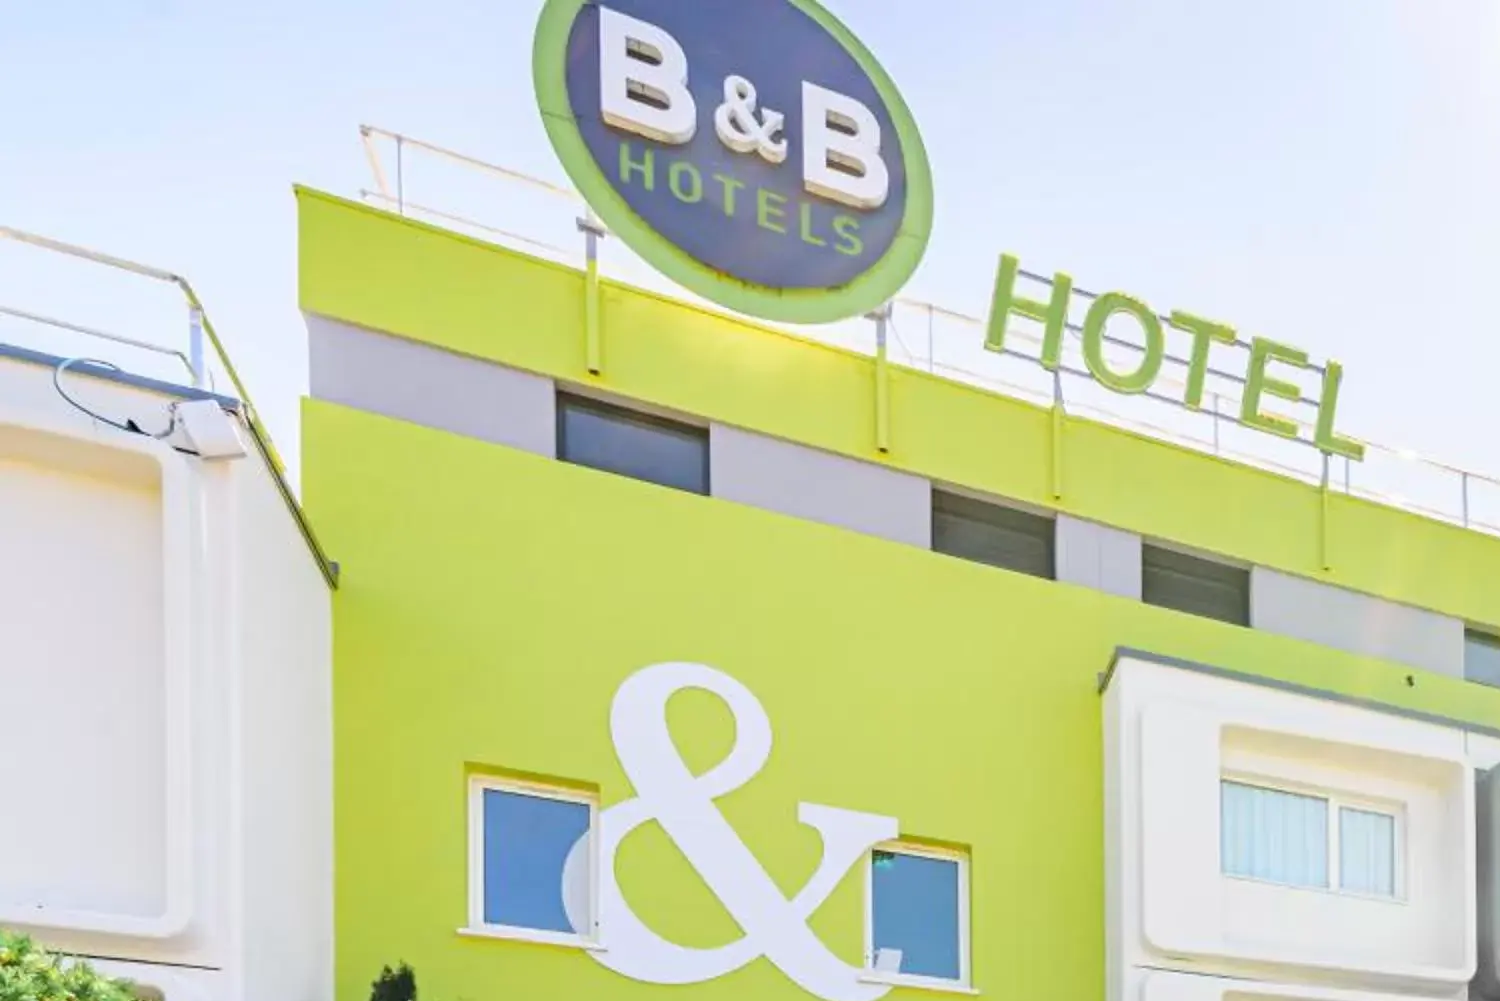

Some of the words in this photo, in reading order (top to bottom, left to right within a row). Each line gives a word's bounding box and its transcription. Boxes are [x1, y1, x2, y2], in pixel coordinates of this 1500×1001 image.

[599, 6, 889, 211] B&B
[617, 141, 865, 257] HOTELS
[983, 251, 1366, 462] HOTEL
